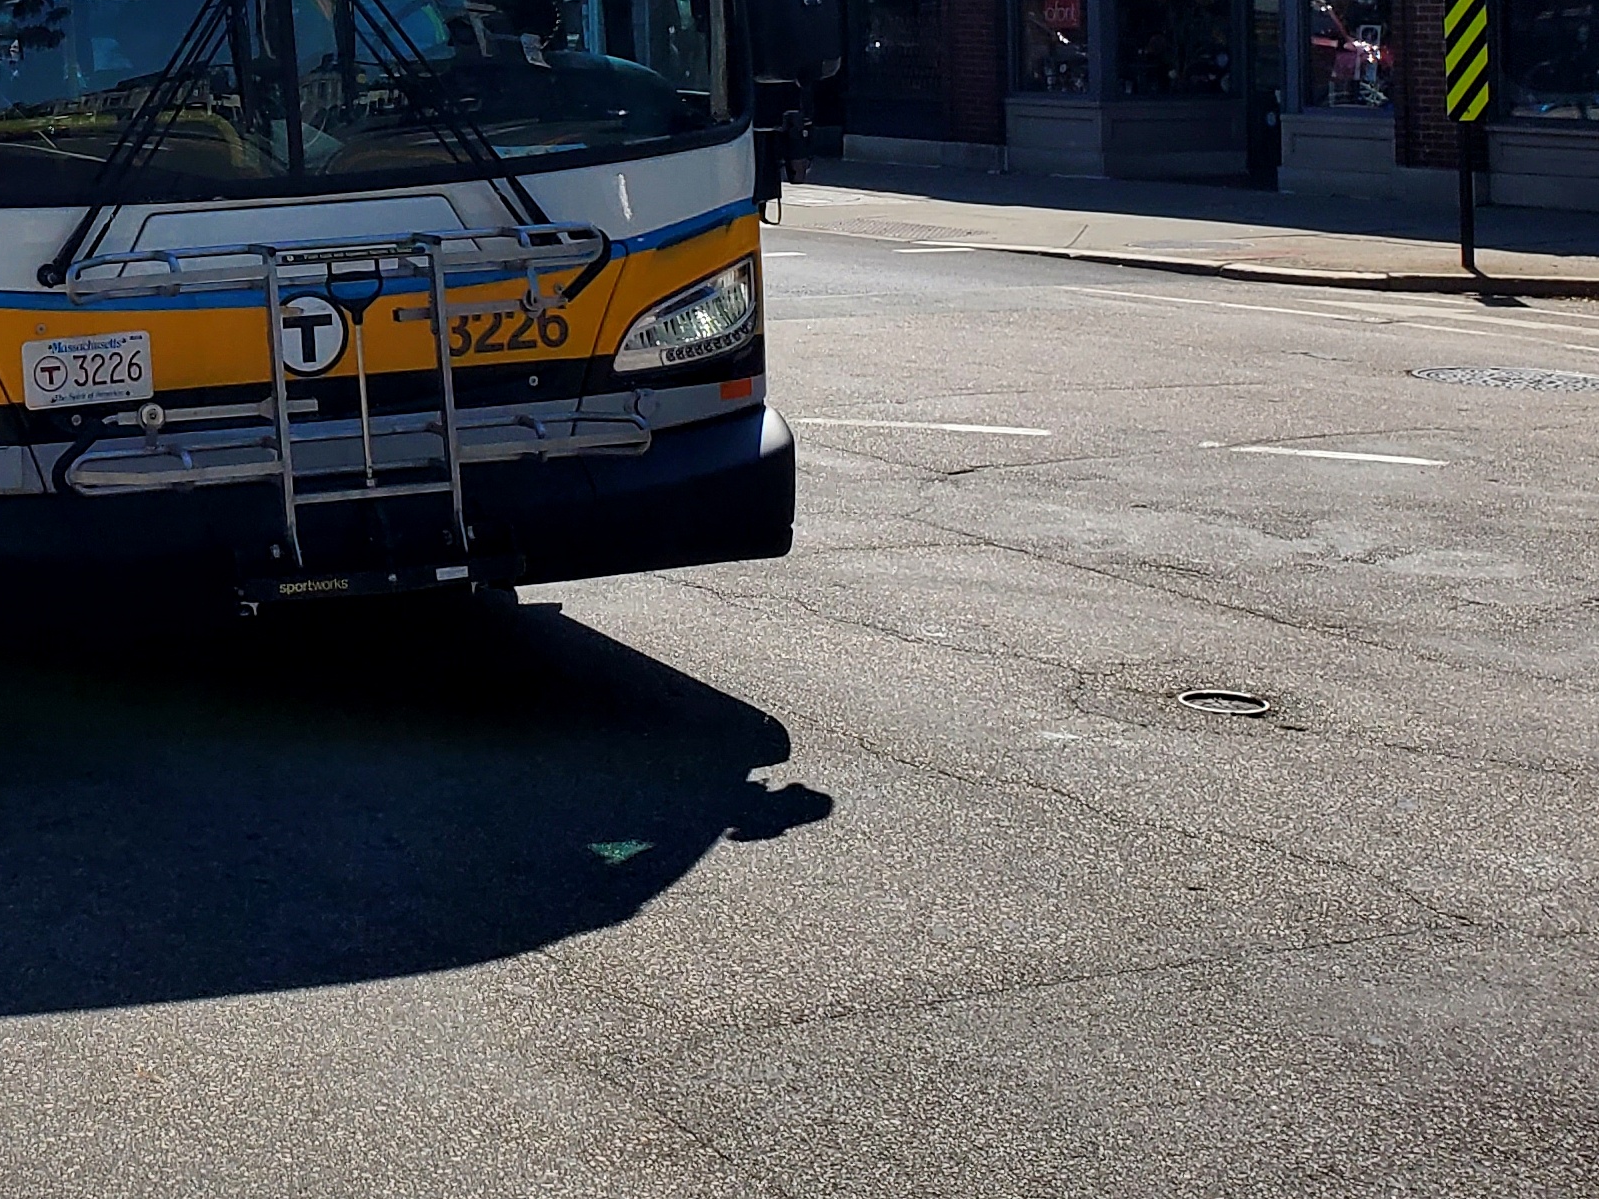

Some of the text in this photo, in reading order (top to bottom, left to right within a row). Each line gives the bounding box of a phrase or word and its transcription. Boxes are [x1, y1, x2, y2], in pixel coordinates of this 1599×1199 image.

[51, 338, 122, 354] Massachusetts
[281, 313, 333, 363] T
[446, 308, 569, 357] 3226
[73, 350, 143, 387] 3226
[279, 578, 349, 595] sportworks
